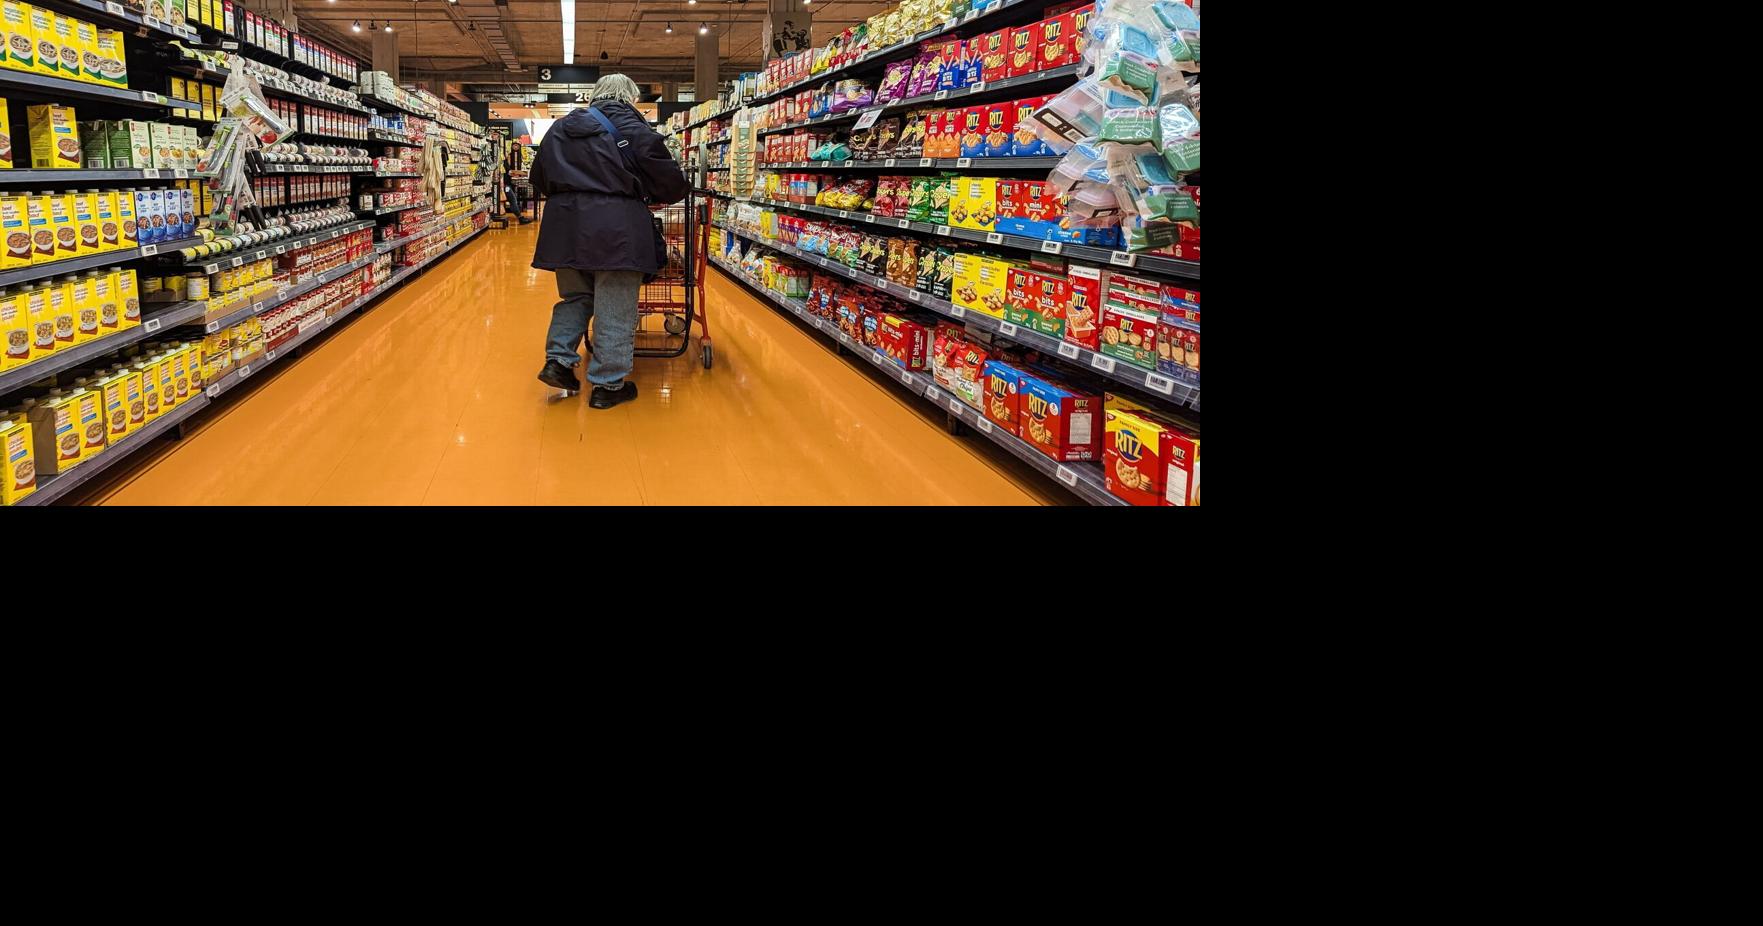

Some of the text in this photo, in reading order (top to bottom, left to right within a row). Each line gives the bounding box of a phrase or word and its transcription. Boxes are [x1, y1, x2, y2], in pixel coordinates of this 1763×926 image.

[1045, 22, 1061, 39] RITZ
[989, 34, 1001, 49] RITZ
[1015, 31, 1030, 48] RITZ
[541, 69, 551, 80] 3
[576, 92, 590, 102] 26
[966, 113, 979, 127] RITZ
[989, 111, 1003, 126] RITZ
[1002, 184, 1012, 196] RITZ
[1030, 185, 1042, 197] RITZ
[1014, 273, 1026, 286] RITZ
[1013, 288, 1024, 298] bits
[1041, 280, 1054, 294] RITZ
[1041, 295, 1054, 306] bits
[1072, 291, 1087, 307] RITZ
[1121, 318, 1134, 331] RITZ
[965, 350, 979, 364] RITZ
[992, 374, 1007, 396] RITZ
[1029, 392, 1047, 418] RITZ
[1115, 430, 1143, 460] RITZ
[1172, 445, 1185, 459] RITZ
